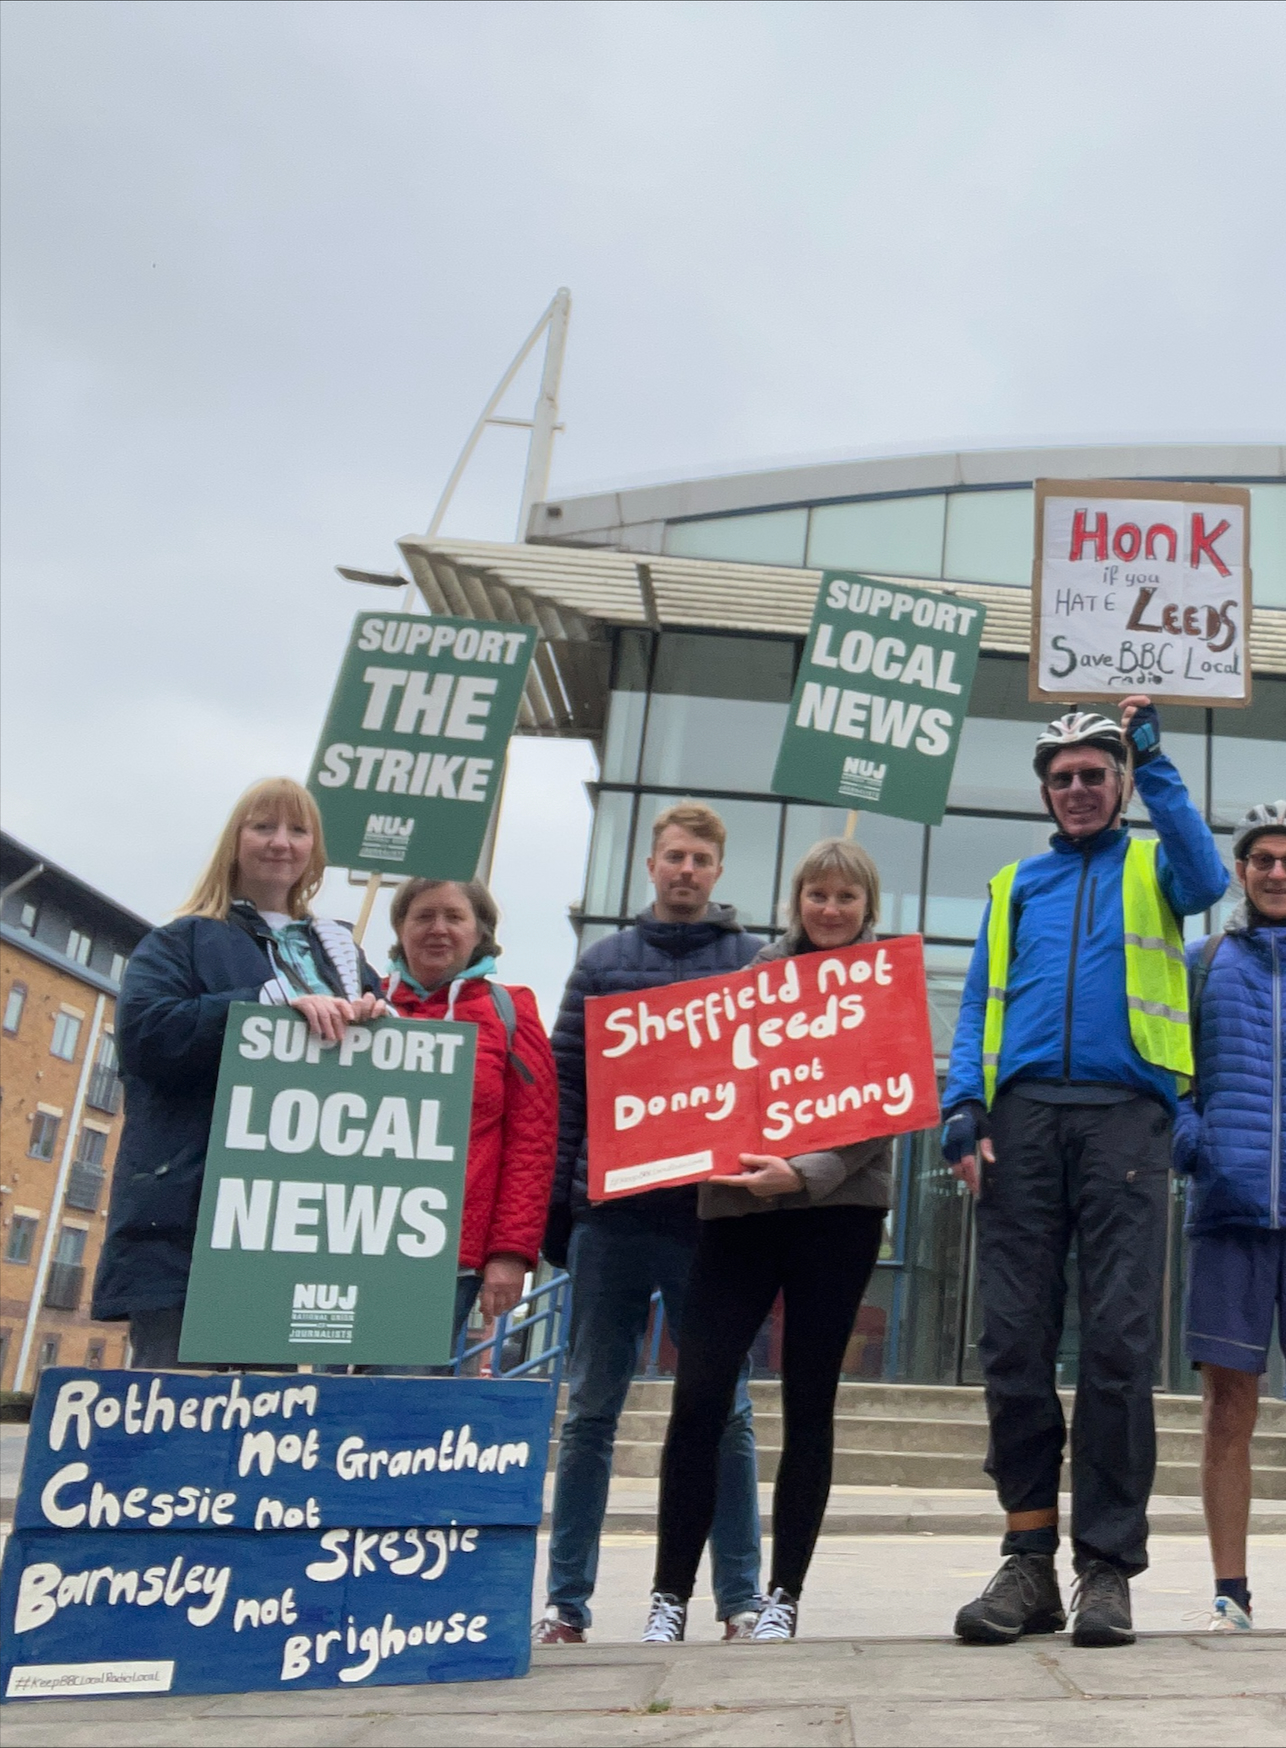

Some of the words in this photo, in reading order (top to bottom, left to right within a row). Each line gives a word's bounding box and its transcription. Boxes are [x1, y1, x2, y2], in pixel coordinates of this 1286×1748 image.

[1055, 588, 1116, 617] HATE
[1102, 565, 1119, 585] if
[1125, 574, 1160, 585] you
[826, 580, 977, 636] SUPPORT
[357, 618, 527, 665] SUPPORT
[811, 624, 961, 695] LOCAL
[1049, 635, 1114, 678] Save
[1117, 641, 1174, 674] BBC
[1184, 647, 1241, 680] Local
[362, 667, 498, 741] THE
[1108, 671, 1163, 685] radio
[796, 682, 953, 757] NEWS
[318, 743, 493, 802] STRIKE
[843, 756, 886, 779] NUJ
[366, 814, 414, 836] NUJ
[603, 959, 800, 1058] Sheffield
[818, 949, 892, 993] not
[732, 994, 865, 1070] Leeds
[239, 1016, 464, 1074] SUPPORT
[225, 1085, 454, 1161] LOCAL
[615, 1082, 737, 1131] Donny
[770, 1057, 824, 1091] not
[763, 1073, 914, 1141] Scunny
[211, 1178, 448, 1258] NEWS
[293, 1284, 358, 1310] NUJ
[289, 1330, 353, 1339] JOURNALISTS
[49, 1378, 318, 1452] Rotherham
[239, 1429, 320, 1477] not
[336, 1425, 530, 1481] Grantham
[41, 1463, 237, 1528] Chessie
[254, 1497, 321, 1531] not
[306, 1520, 479, 1582] Skeggie
[14, 1556, 231, 1634] Barnsley
[233, 1588, 298, 1632] not
[281, 1613, 488, 1683] Brighouse
